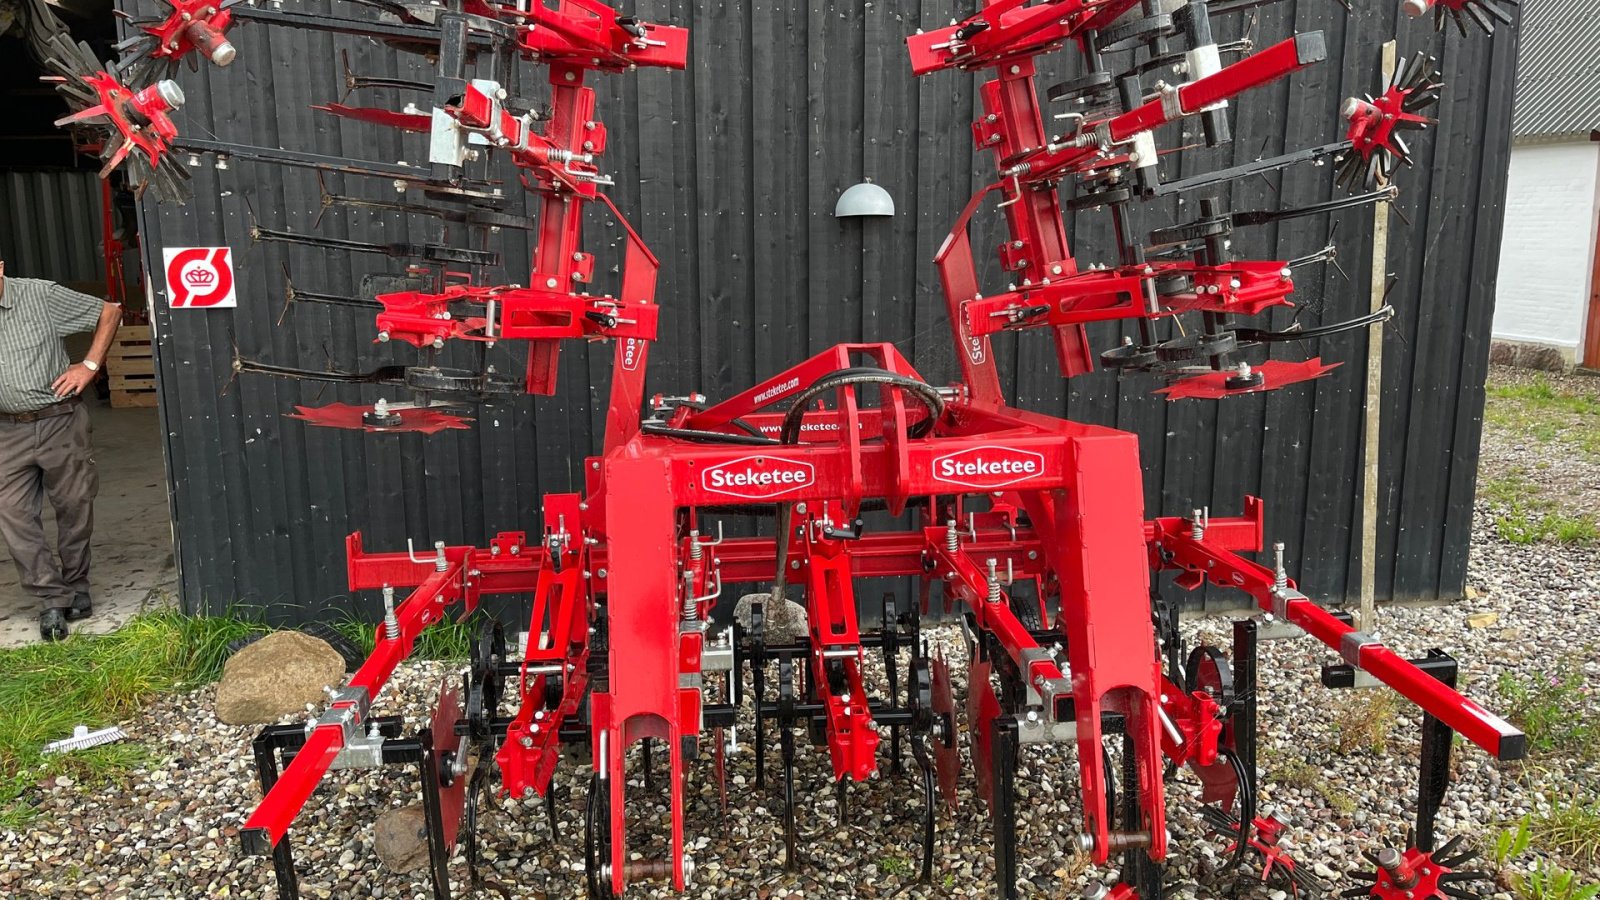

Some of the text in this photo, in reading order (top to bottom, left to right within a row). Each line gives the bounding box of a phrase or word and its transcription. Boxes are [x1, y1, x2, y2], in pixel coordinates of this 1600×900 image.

[624, 337, 635, 365] etee
[753, 377, 799, 404] www.steketee.com
[711, 468, 806, 487] Steketee
[941, 458, 1036, 476] Steketee
